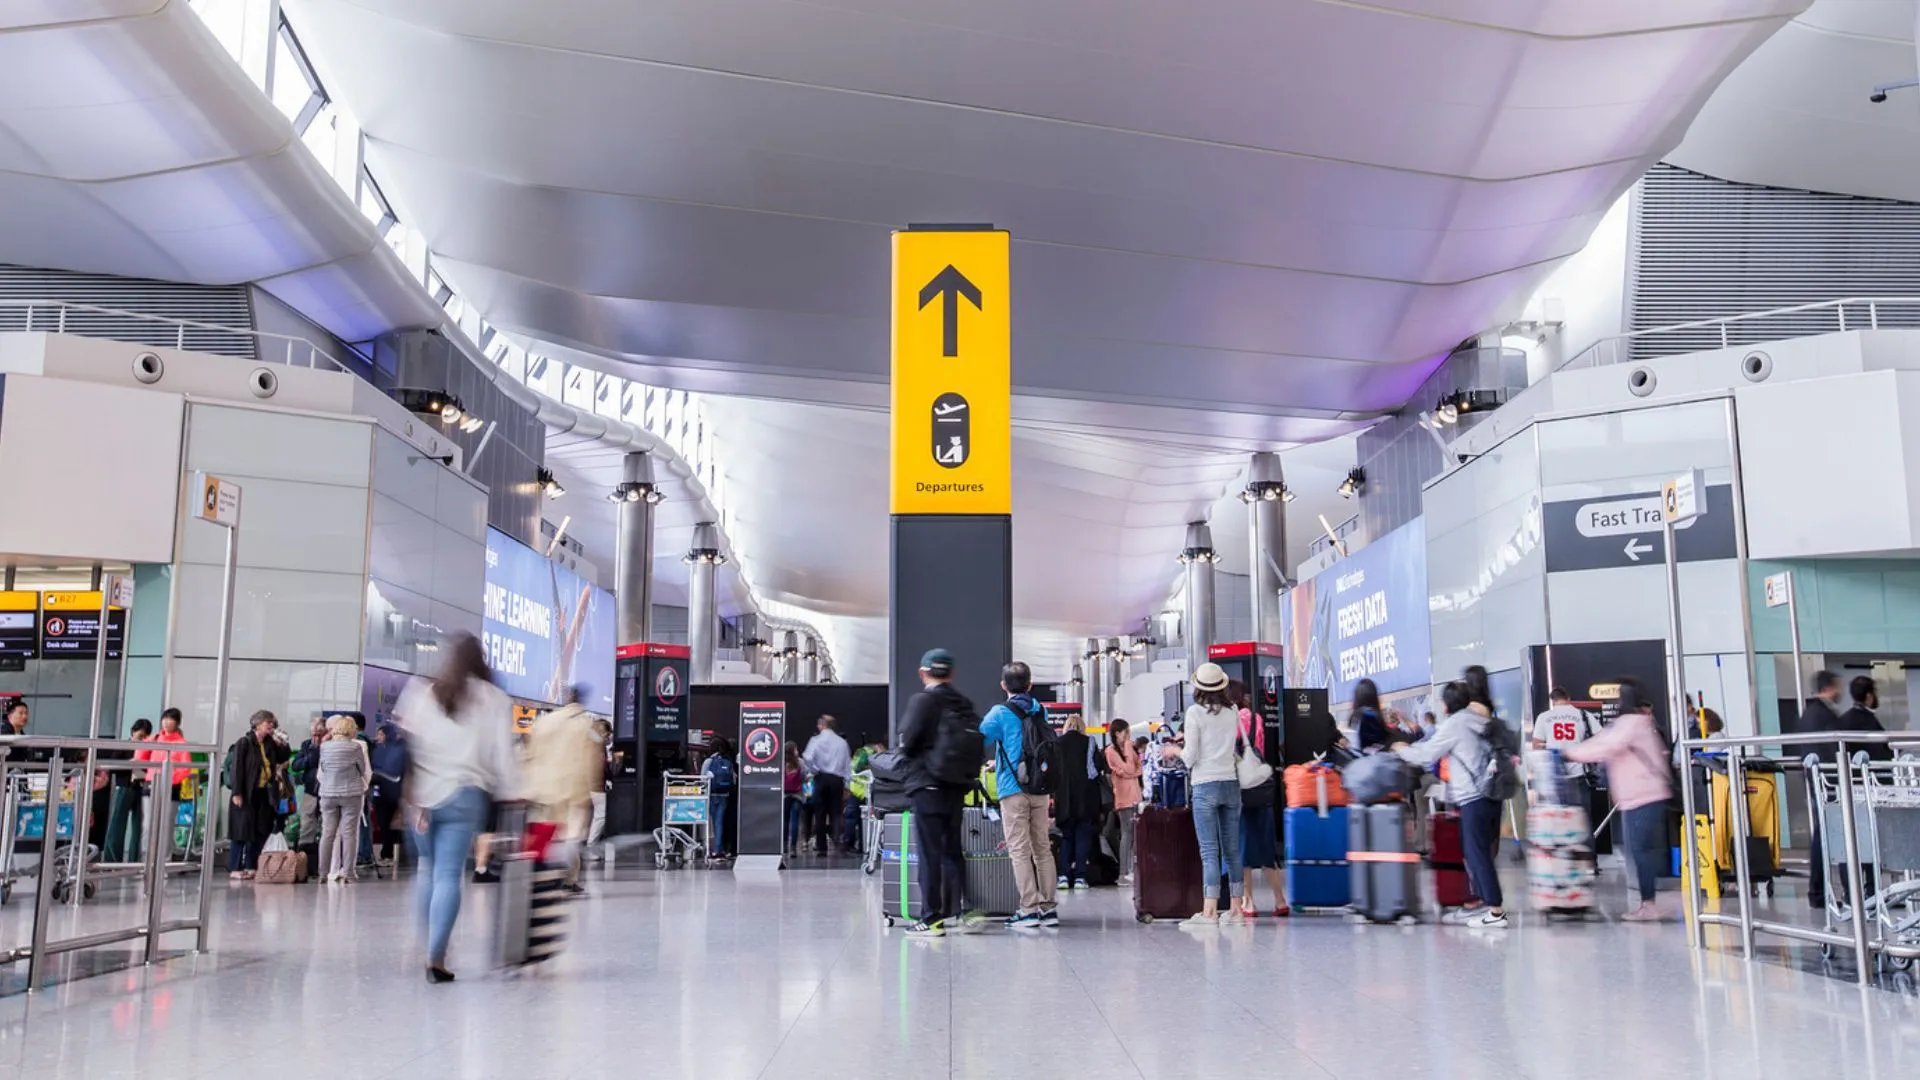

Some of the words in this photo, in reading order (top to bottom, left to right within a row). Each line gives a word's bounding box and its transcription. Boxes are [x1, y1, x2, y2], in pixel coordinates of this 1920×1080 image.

[916, 482, 984, 494] Departures
[1591, 510, 1627, 528] Fast
[1632, 508, 1662, 524] Tra
[507, 591, 550, 640] LEARNING
[1337, 599, 1365, 641] FRESH
[1365, 590, 1388, 630] DATA
[1340, 645, 1366, 683] FEEDS
[1553, 722, 1575, 741] 65
